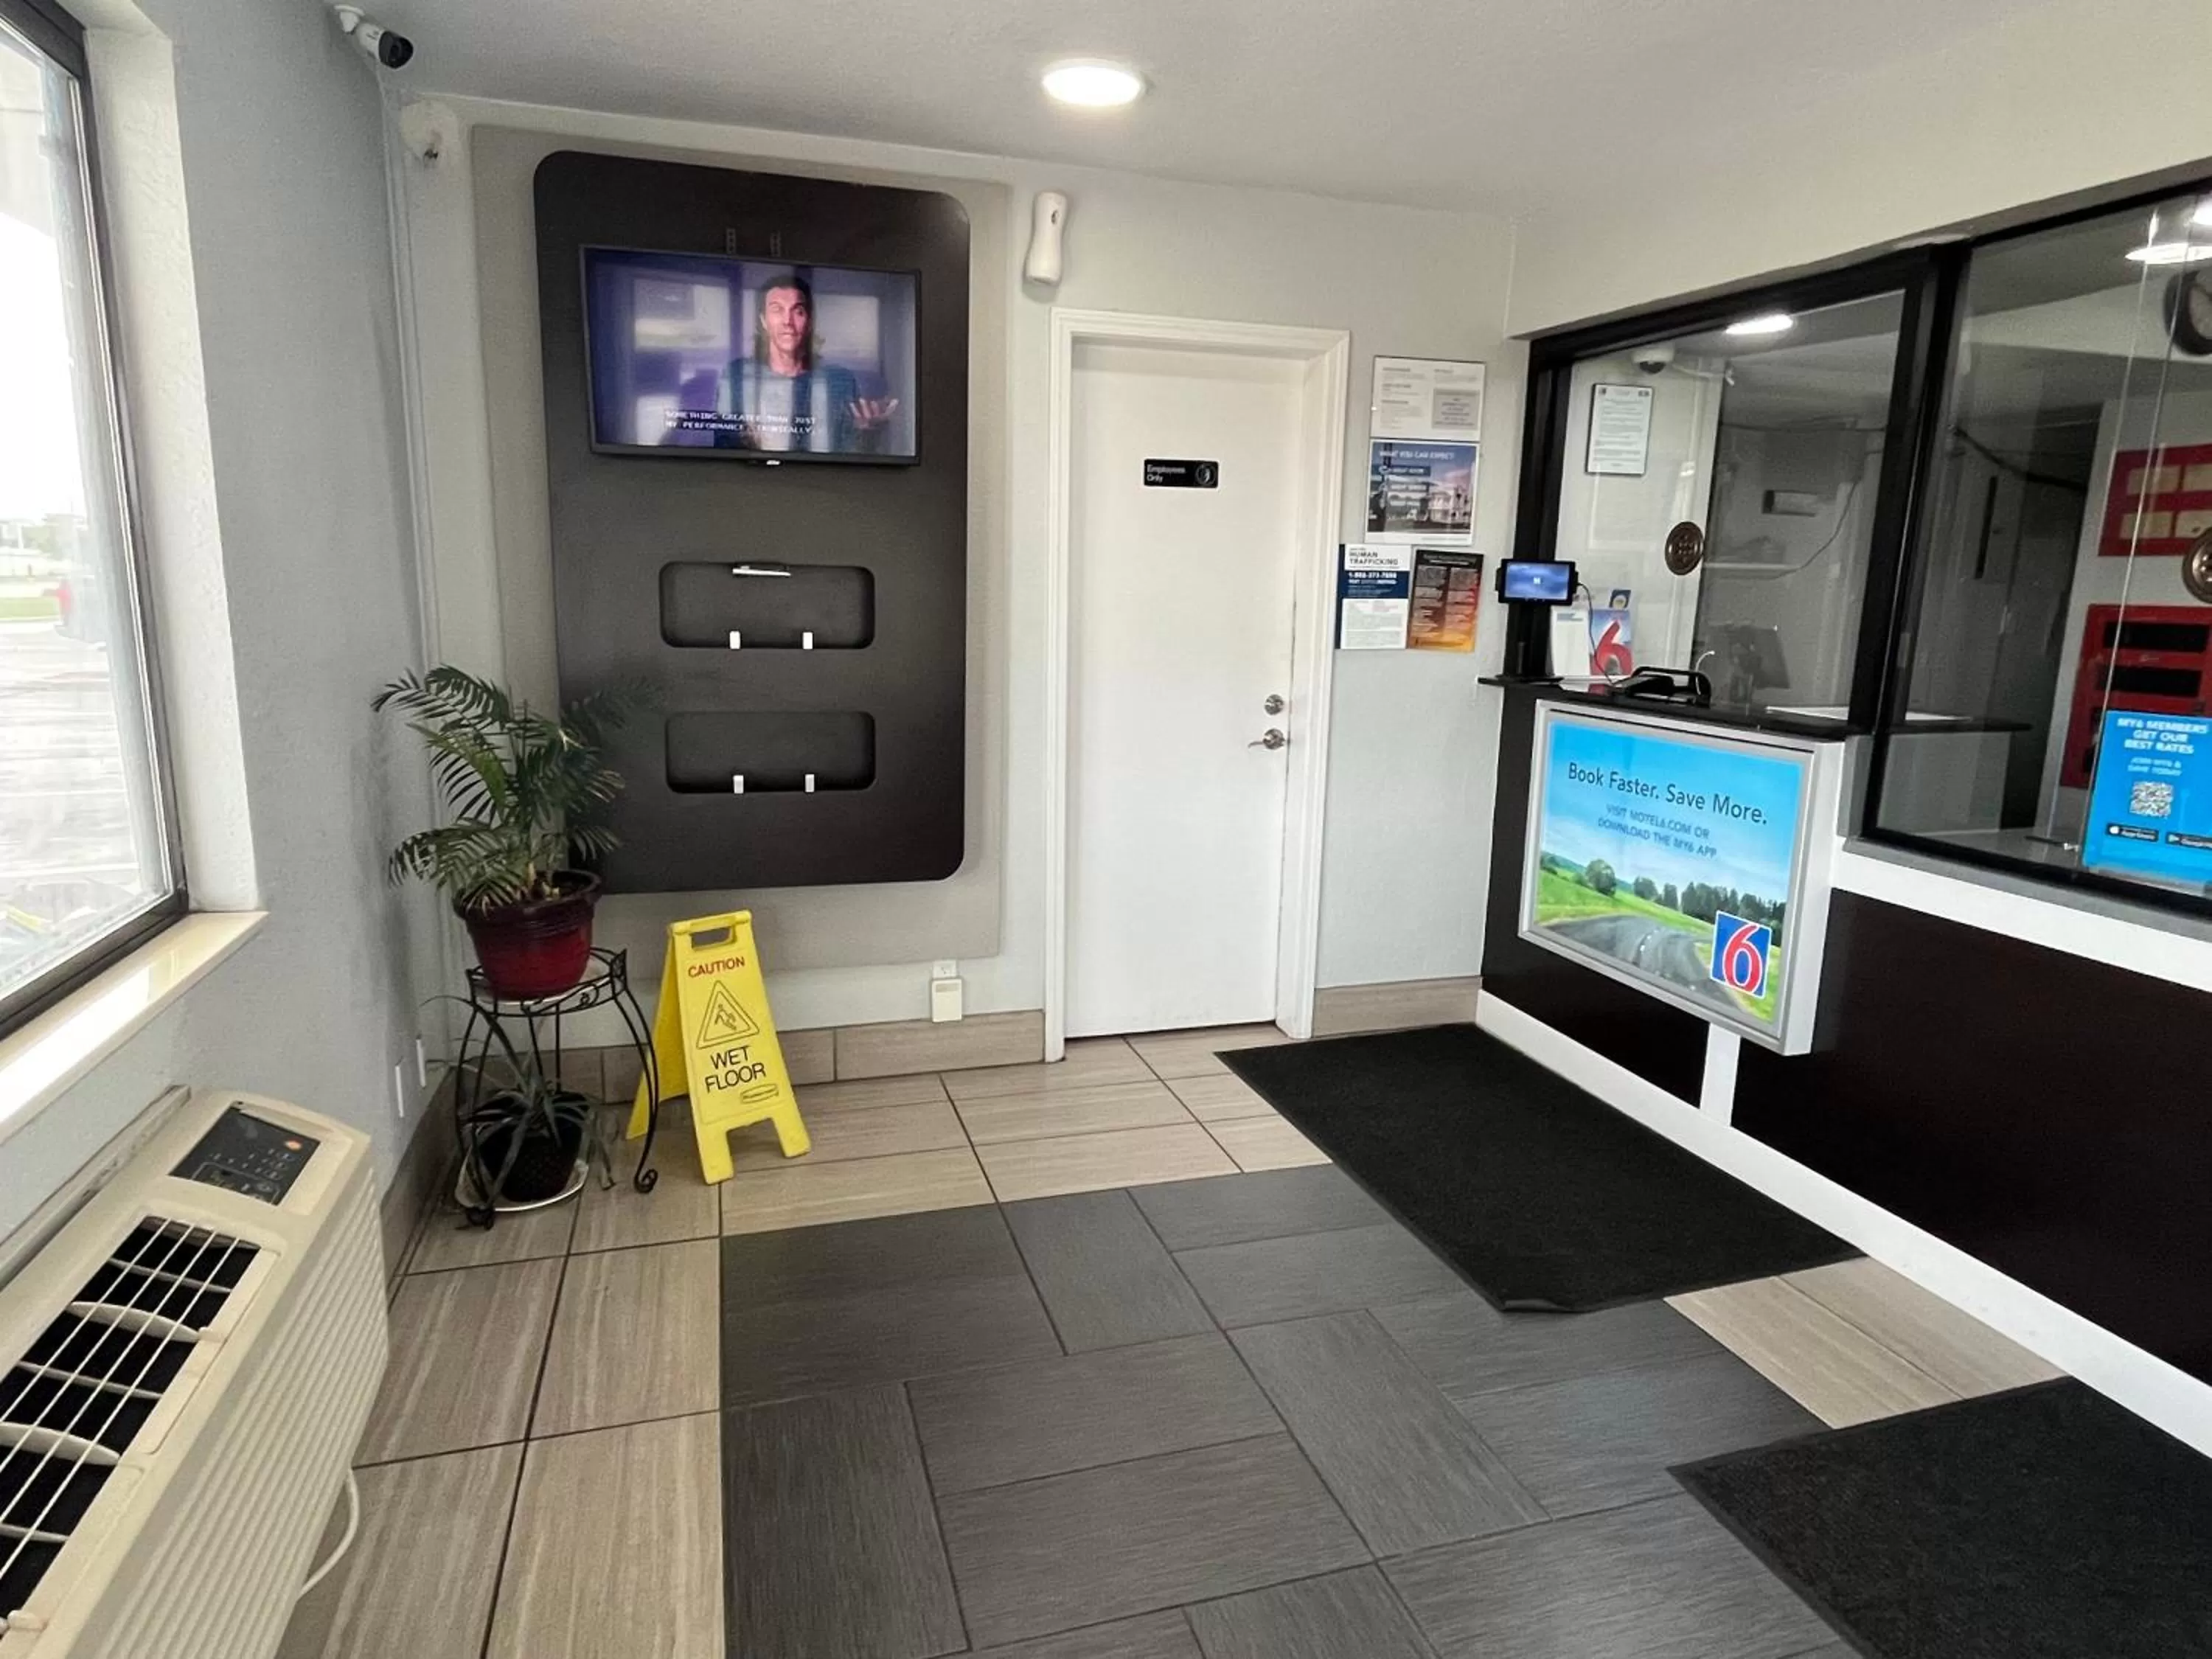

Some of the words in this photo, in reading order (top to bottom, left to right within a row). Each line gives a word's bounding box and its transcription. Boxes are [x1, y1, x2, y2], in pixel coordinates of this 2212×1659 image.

[666, 410, 717, 421] SOMETHING
[795, 417, 815, 425] JUST
[1147, 474, 1163, 484] Only
[2133, 729, 2158, 740] GET
[2160, 732, 2189, 743] OUR
[2146, 720, 2208, 734] MEMBERS
[2124, 739, 2154, 750] BEST
[2155, 742, 2195, 754] RATES
[1568, 762, 1604, 787] Book
[1609, 771, 1659, 800] Faster.
[1666, 784, 1705, 810] Save
[1712, 793, 1767, 825] More.
[1606, 804, 1627, 818] VISIT
[1630, 810, 1691, 835] MOTEL6.COM
[1694, 826, 1710, 839] OR
[1598, 817, 1651, 841] DOWNLOAD
[1652, 831, 1671, 846] THE
[1672, 837, 1694, 853] MY6
[1697, 845, 1717, 858] APP
[687, 956, 745, 978] CAUTION
[1722, 922, 1762, 994] 6
[710, 1044, 751, 1070] WET
[704, 1062, 767, 1093] FLOOR
